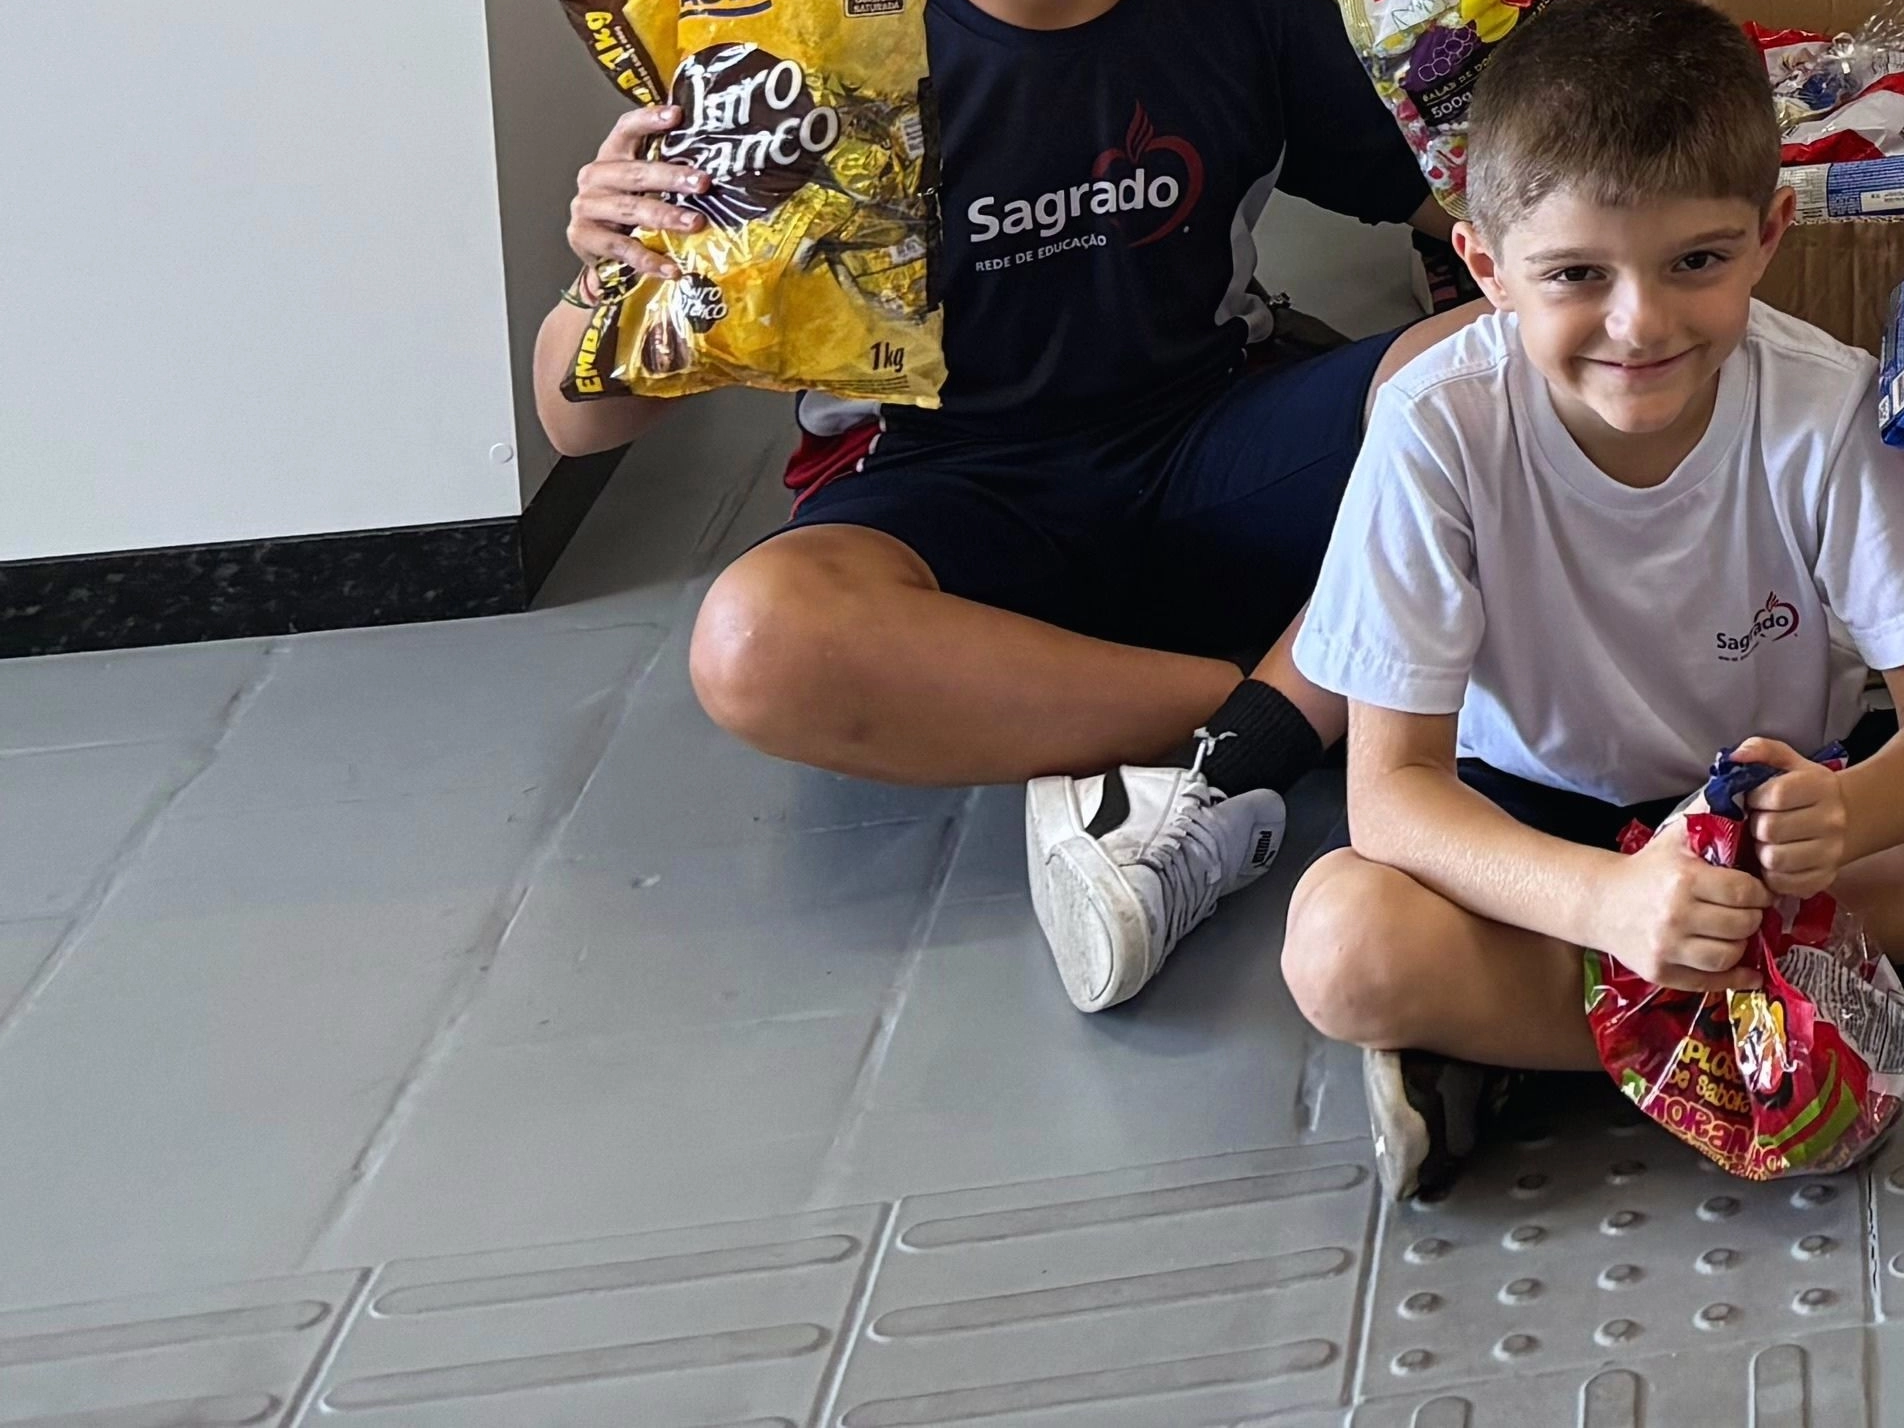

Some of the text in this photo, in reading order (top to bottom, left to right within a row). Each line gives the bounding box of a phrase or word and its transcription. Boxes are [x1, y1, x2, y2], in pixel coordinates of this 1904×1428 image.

[968, 167, 1179, 244] Sagrado
[975, 232, 1108, 273] REDE DE EDUCAÇÃO
[870, 342, 905, 373] 1kg
